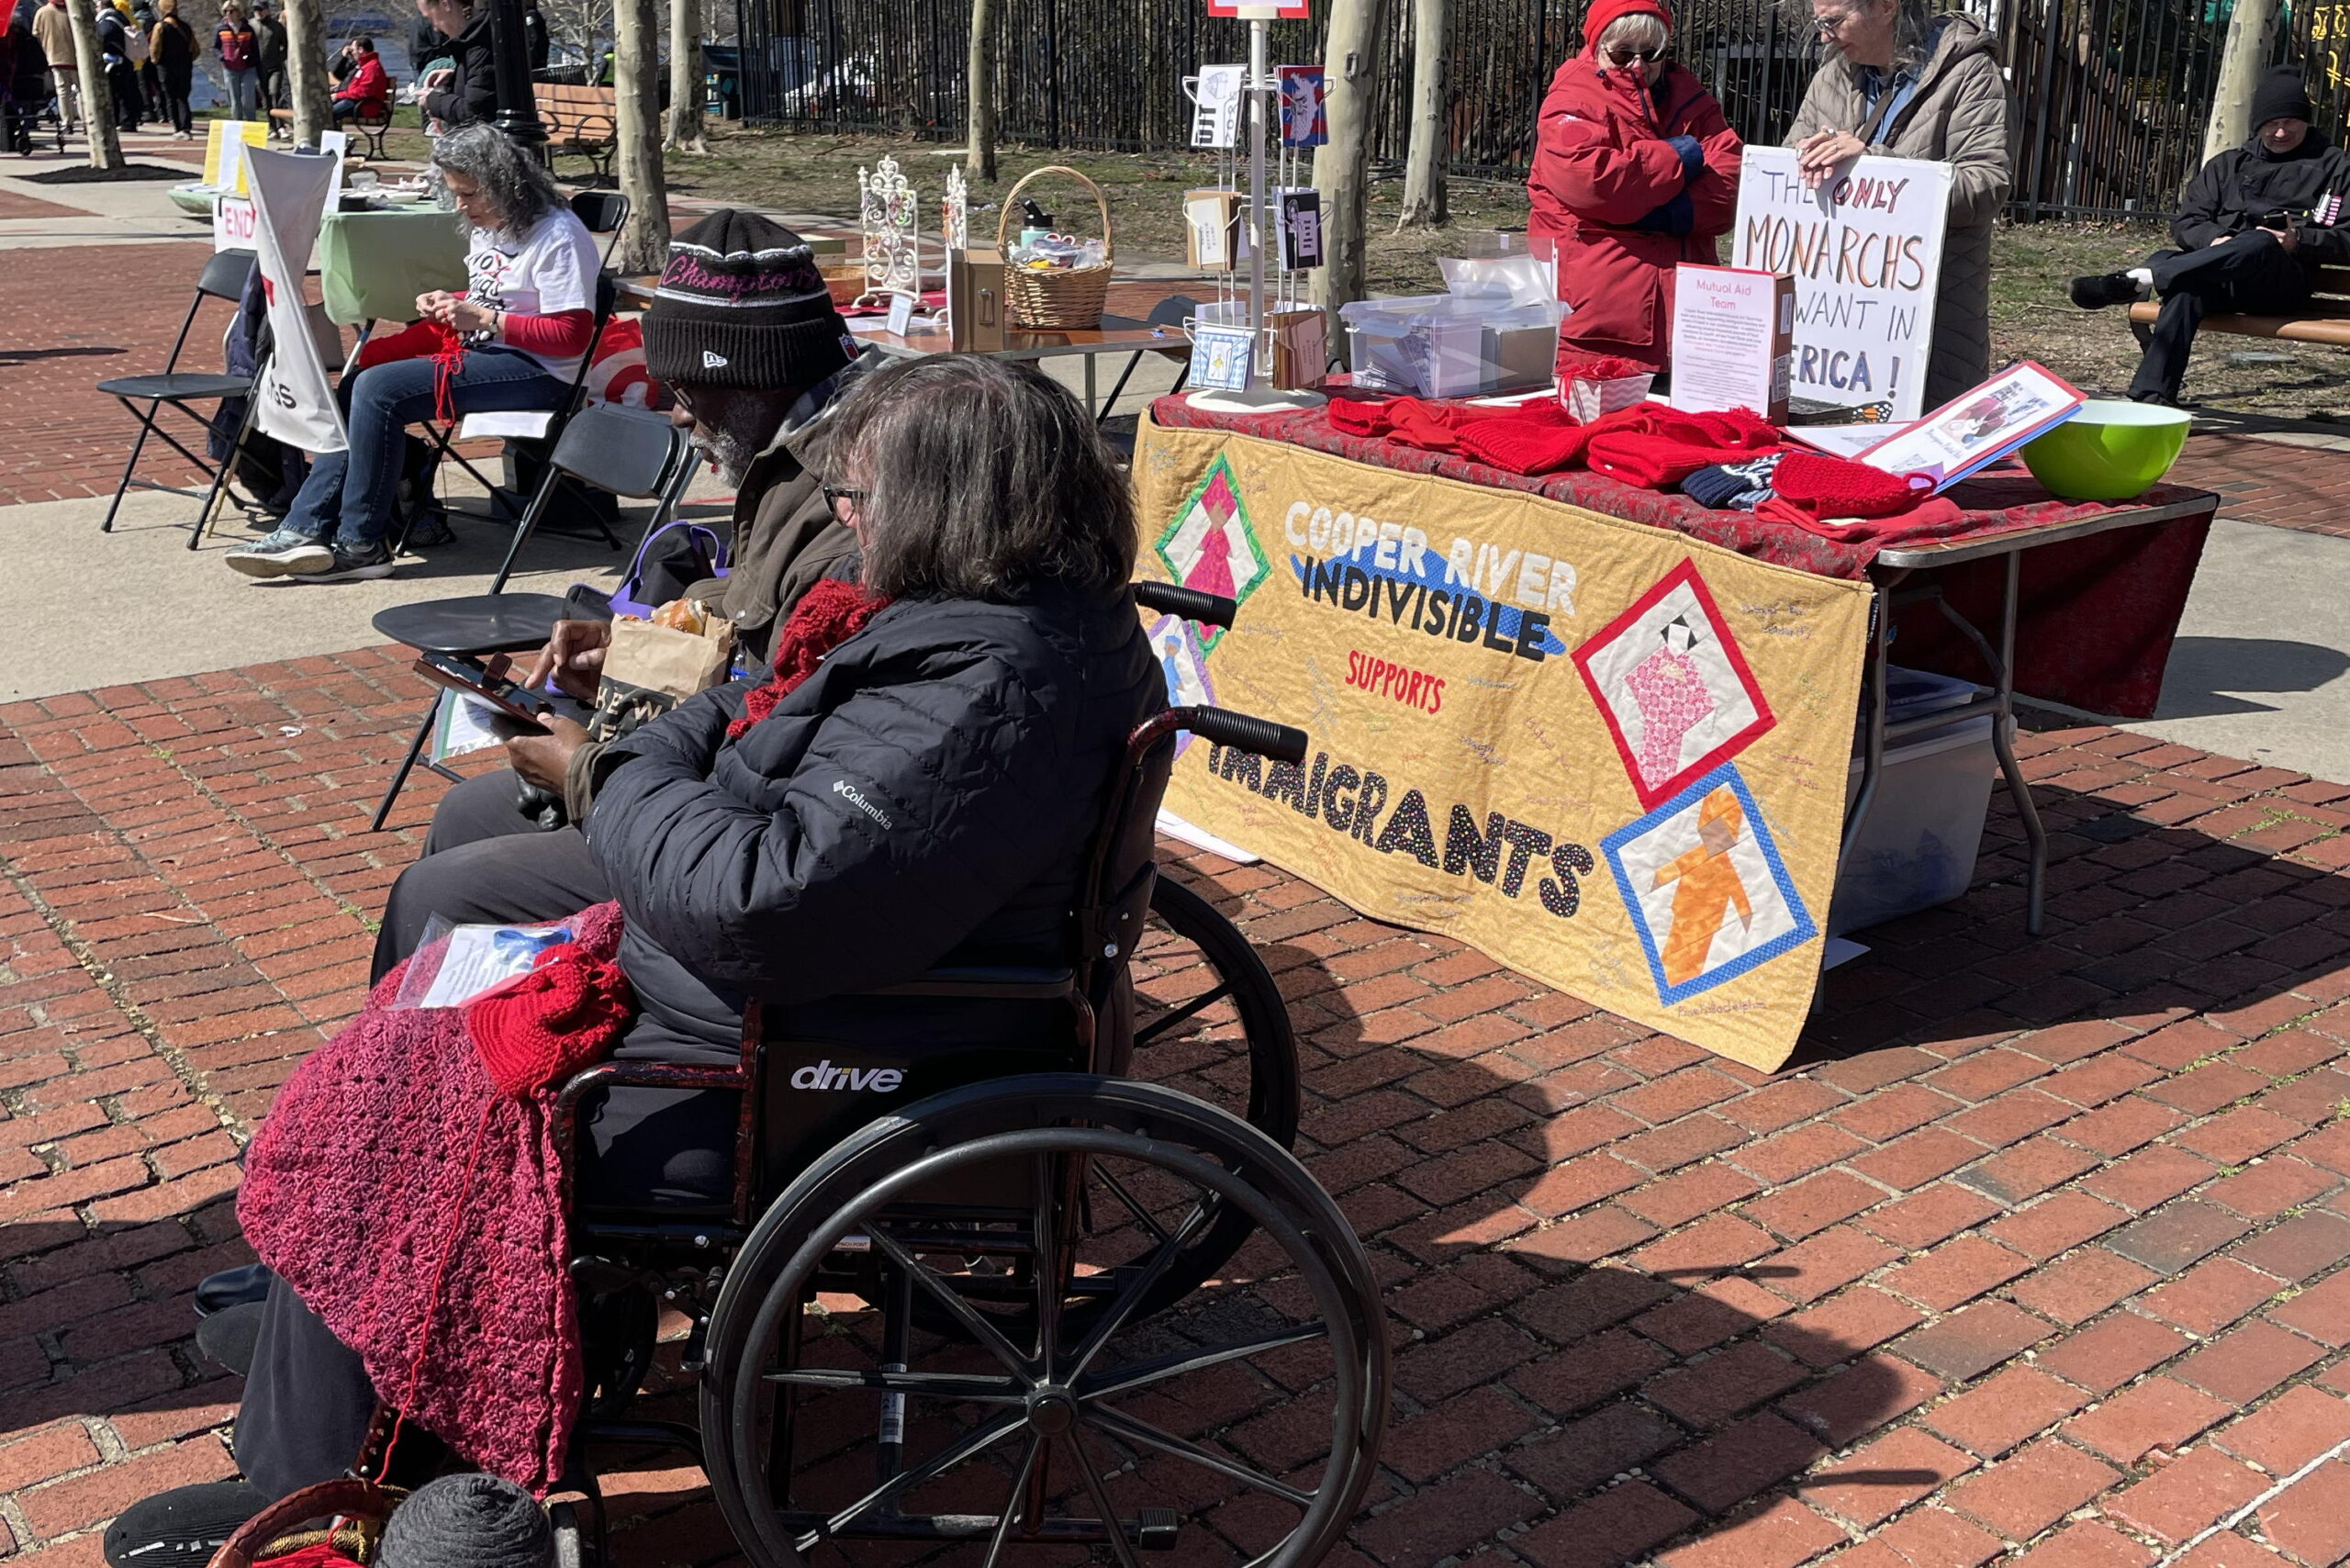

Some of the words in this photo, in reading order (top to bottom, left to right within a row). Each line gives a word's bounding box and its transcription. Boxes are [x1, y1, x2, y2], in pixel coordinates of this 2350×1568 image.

[1832, 175, 1910, 214] ONLY
[1744, 213, 1925, 292] MONARCHS
[1695, 278, 1732, 294] Mutual
[1734, 283, 1752, 296] Aid
[1710, 296, 1737, 309] Team
[1793, 291, 1879, 330] WANT
[1886, 305, 1917, 342] IN
[1284, 500, 1428, 578] COOPER
[1444, 537, 1578, 616] RIVER
[1302, 554, 1551, 662] INDIVISIBLE
[1345, 650, 1447, 715] SUPPORTS
[841, 785, 893, 831] Columbia
[1208, 742, 1595, 919] IMMIGRANTS
[790, 1059, 903, 1093] drive
